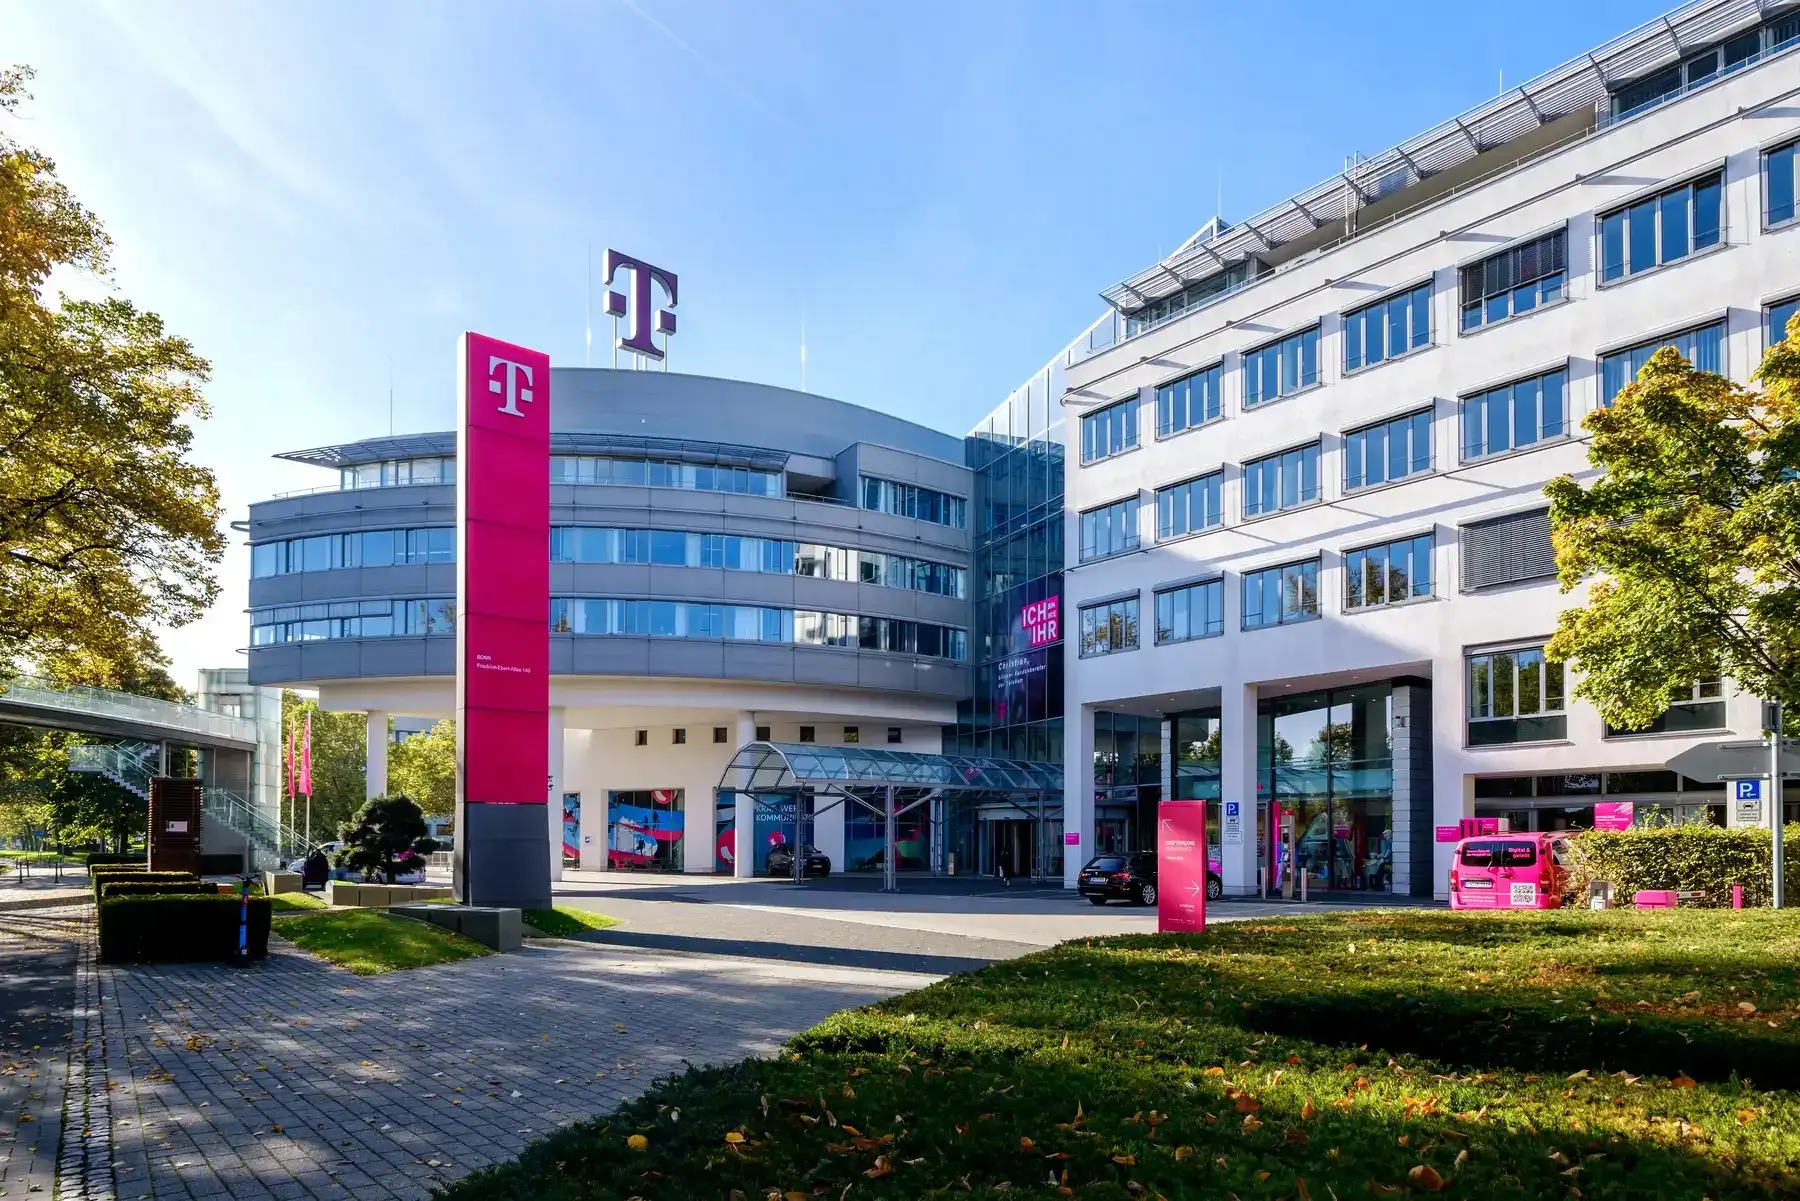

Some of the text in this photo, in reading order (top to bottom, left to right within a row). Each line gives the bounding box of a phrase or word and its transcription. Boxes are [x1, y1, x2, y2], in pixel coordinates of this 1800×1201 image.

[603, 248, 678, 362] T
[489, 355, 533, 418] T
[1023, 602, 1047, 627] ICH
[1032, 620, 1057, 644] IHR
[476, 663, 522, 673] Friedrich-Ebert-Allee
[1740, 782, 1754, 798] P
[1227, 803, 1236, 815] P
